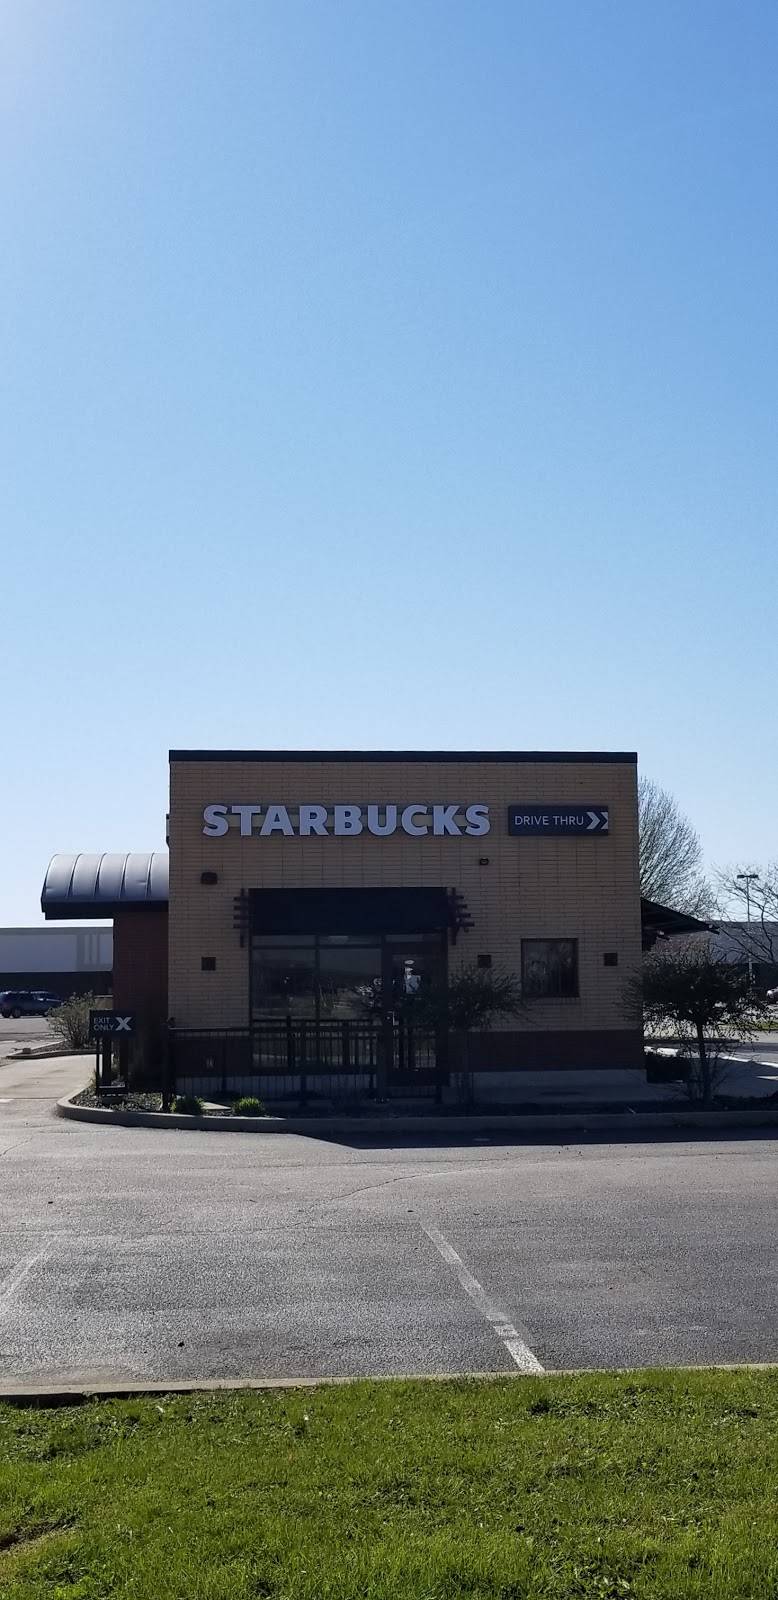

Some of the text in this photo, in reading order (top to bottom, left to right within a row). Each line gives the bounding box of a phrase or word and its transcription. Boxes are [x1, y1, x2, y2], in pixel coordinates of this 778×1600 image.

[202, 804, 491, 837] STARBUCKS
[514, 815, 584, 826] DRIVE THRU
